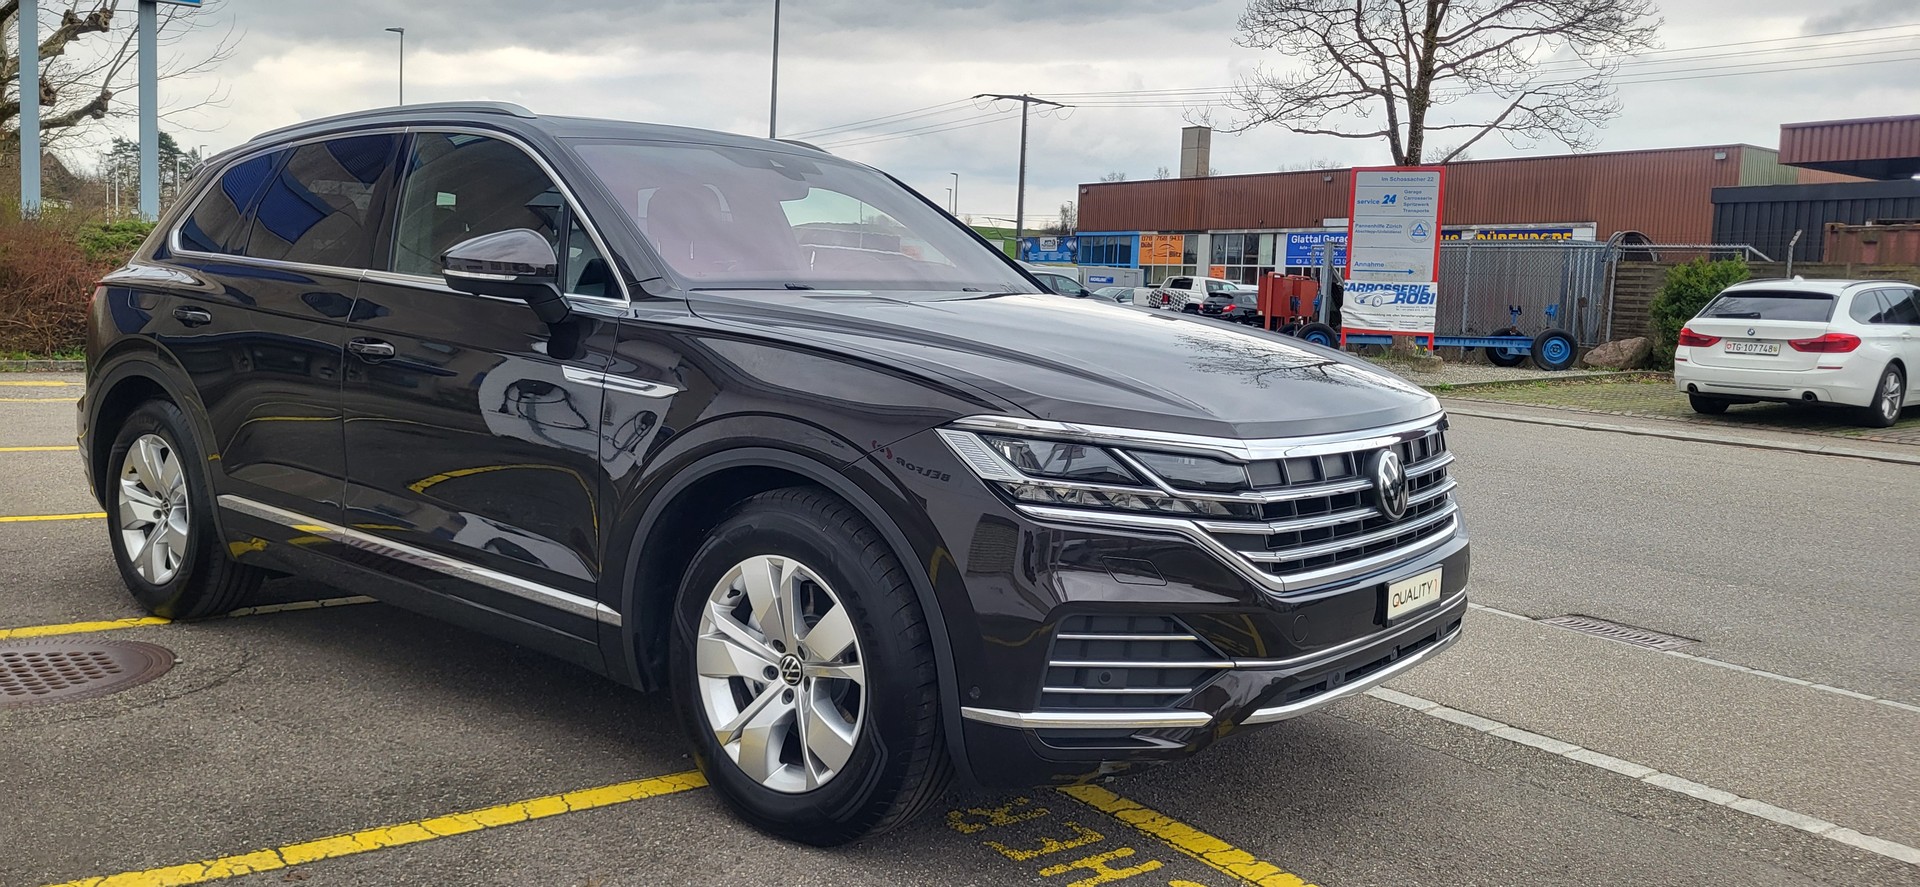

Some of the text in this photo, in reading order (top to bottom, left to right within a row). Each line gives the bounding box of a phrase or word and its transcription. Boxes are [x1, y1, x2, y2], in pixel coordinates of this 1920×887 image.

[1381, 194, 1397, 205] 24
[1291, 234, 1321, 244] Glattal
[1394, 292, 1436, 305] ROBI
